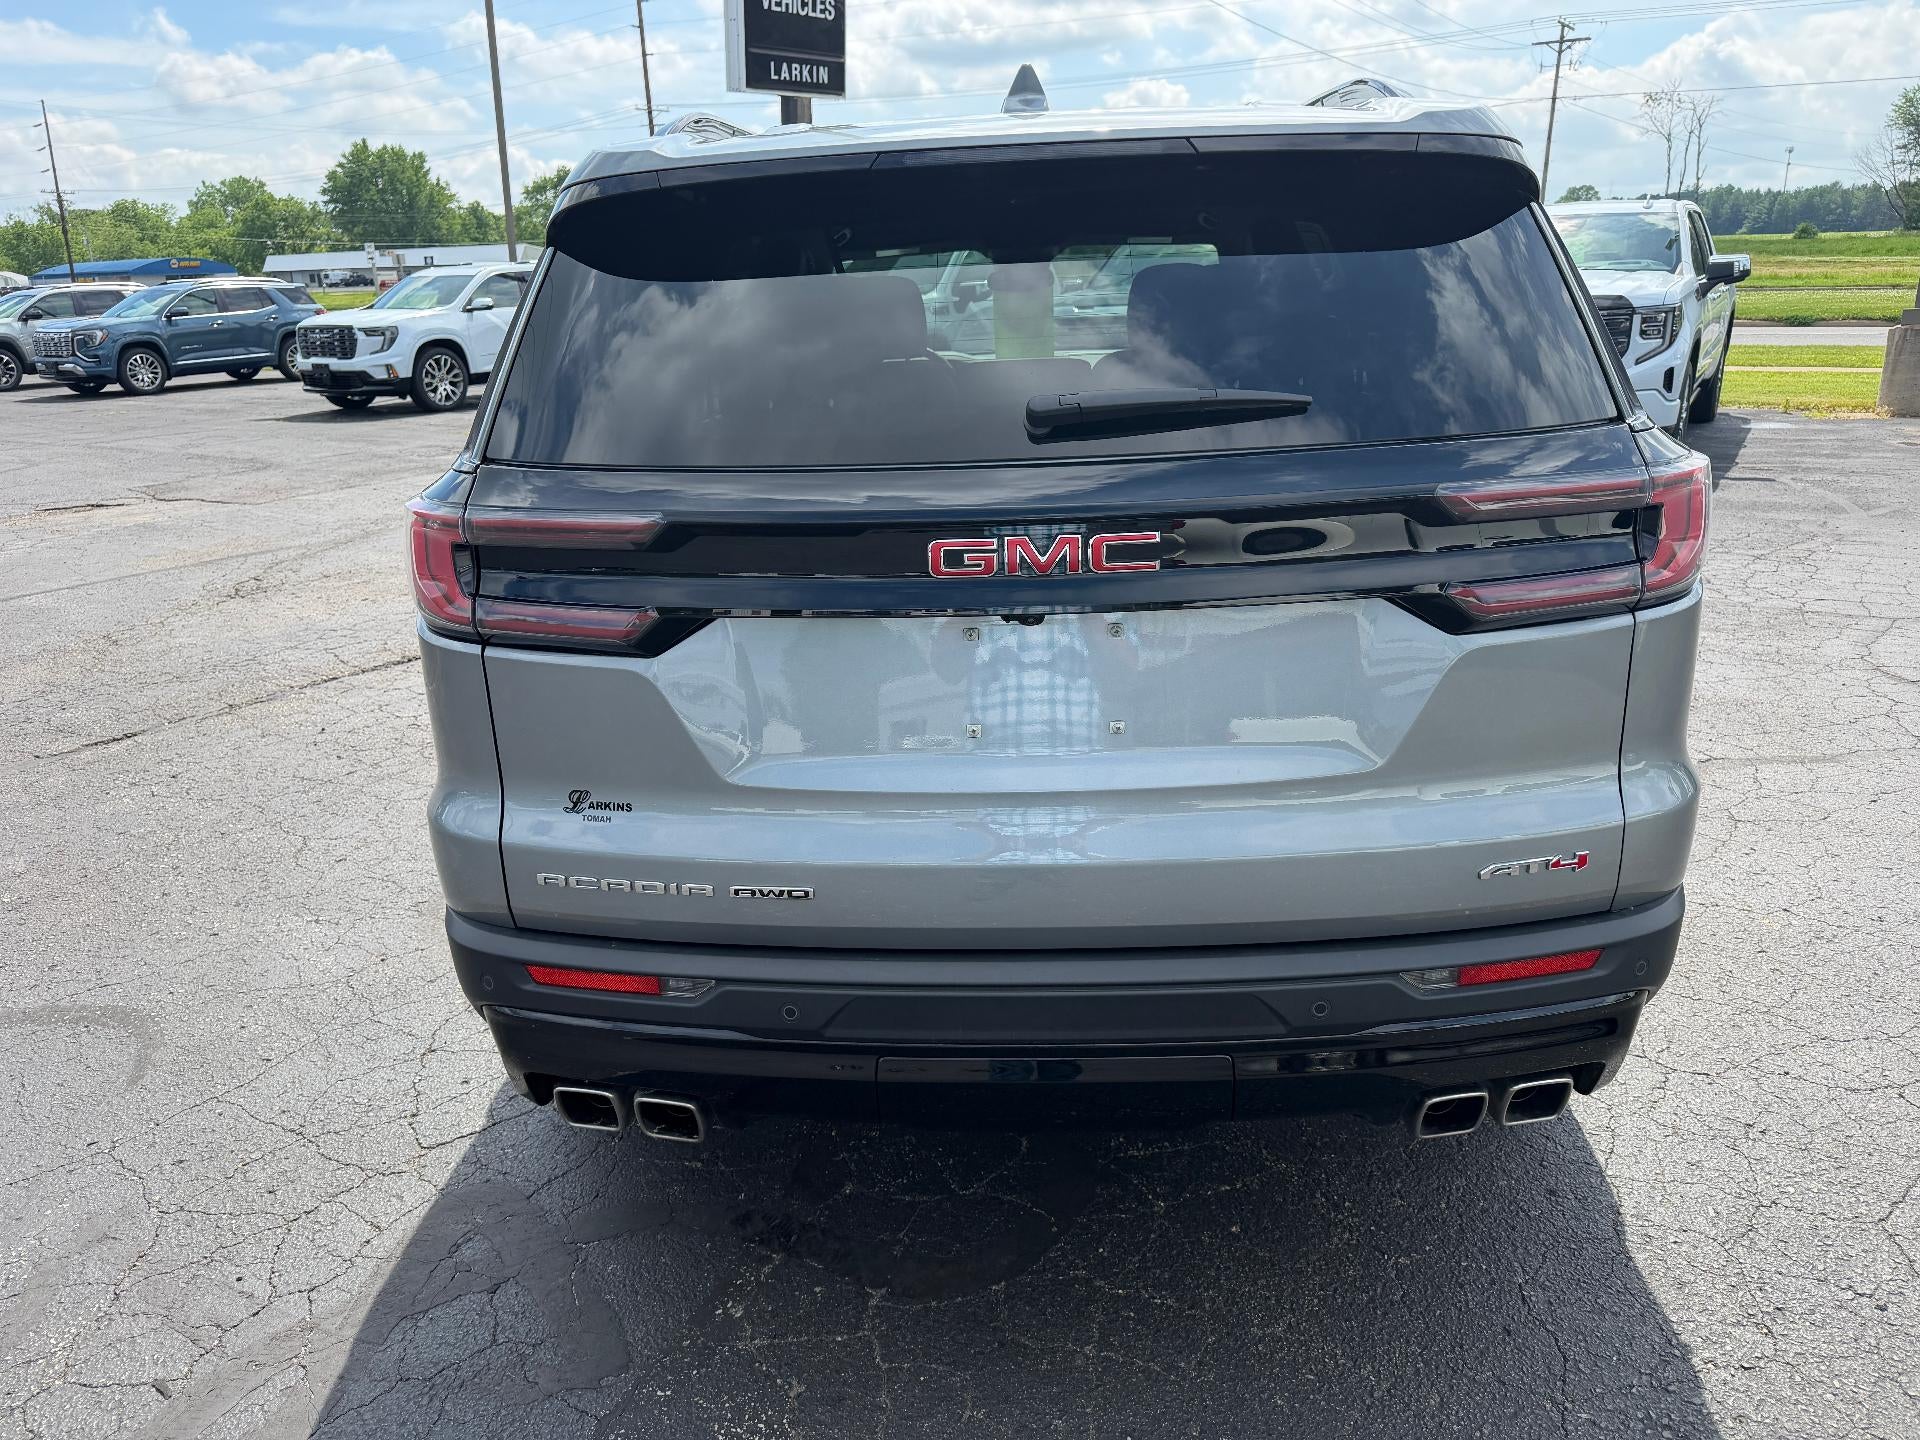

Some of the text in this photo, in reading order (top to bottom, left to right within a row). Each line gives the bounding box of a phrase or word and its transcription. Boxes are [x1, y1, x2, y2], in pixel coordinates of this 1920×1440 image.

[770, 61, 829, 84] LARKIN
[927, 531, 1161, 579] GMC
[581, 814, 612, 823] TOMAH
[1478, 850, 1590, 880] AT4
[536, 872, 813, 900] ACADIA AWD
